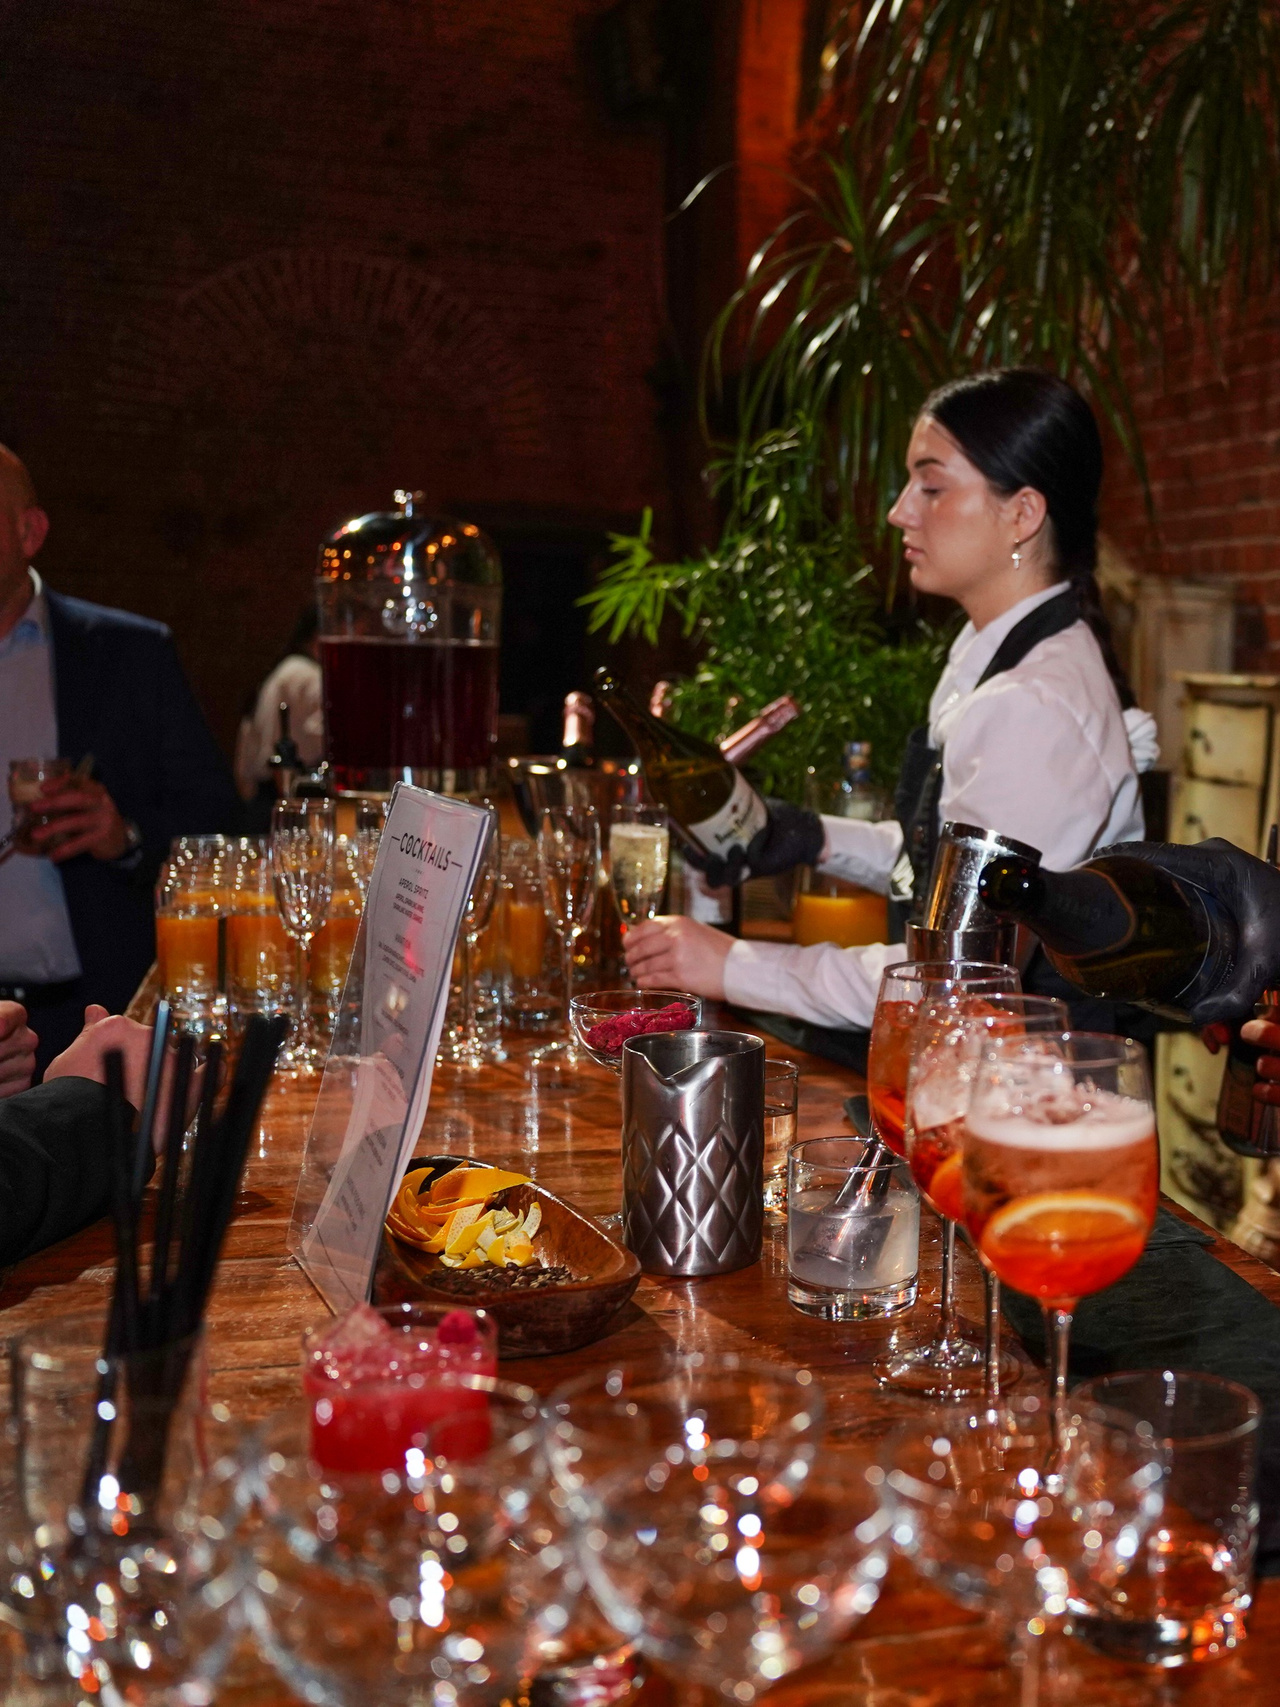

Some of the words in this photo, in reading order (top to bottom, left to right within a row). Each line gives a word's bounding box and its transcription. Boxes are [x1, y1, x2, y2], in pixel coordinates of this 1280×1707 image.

[400, 832, 452, 871] COCKTAILS
[399, 878, 413, 893] APEROL
[413, 884, 429, 899] SPRITZ
